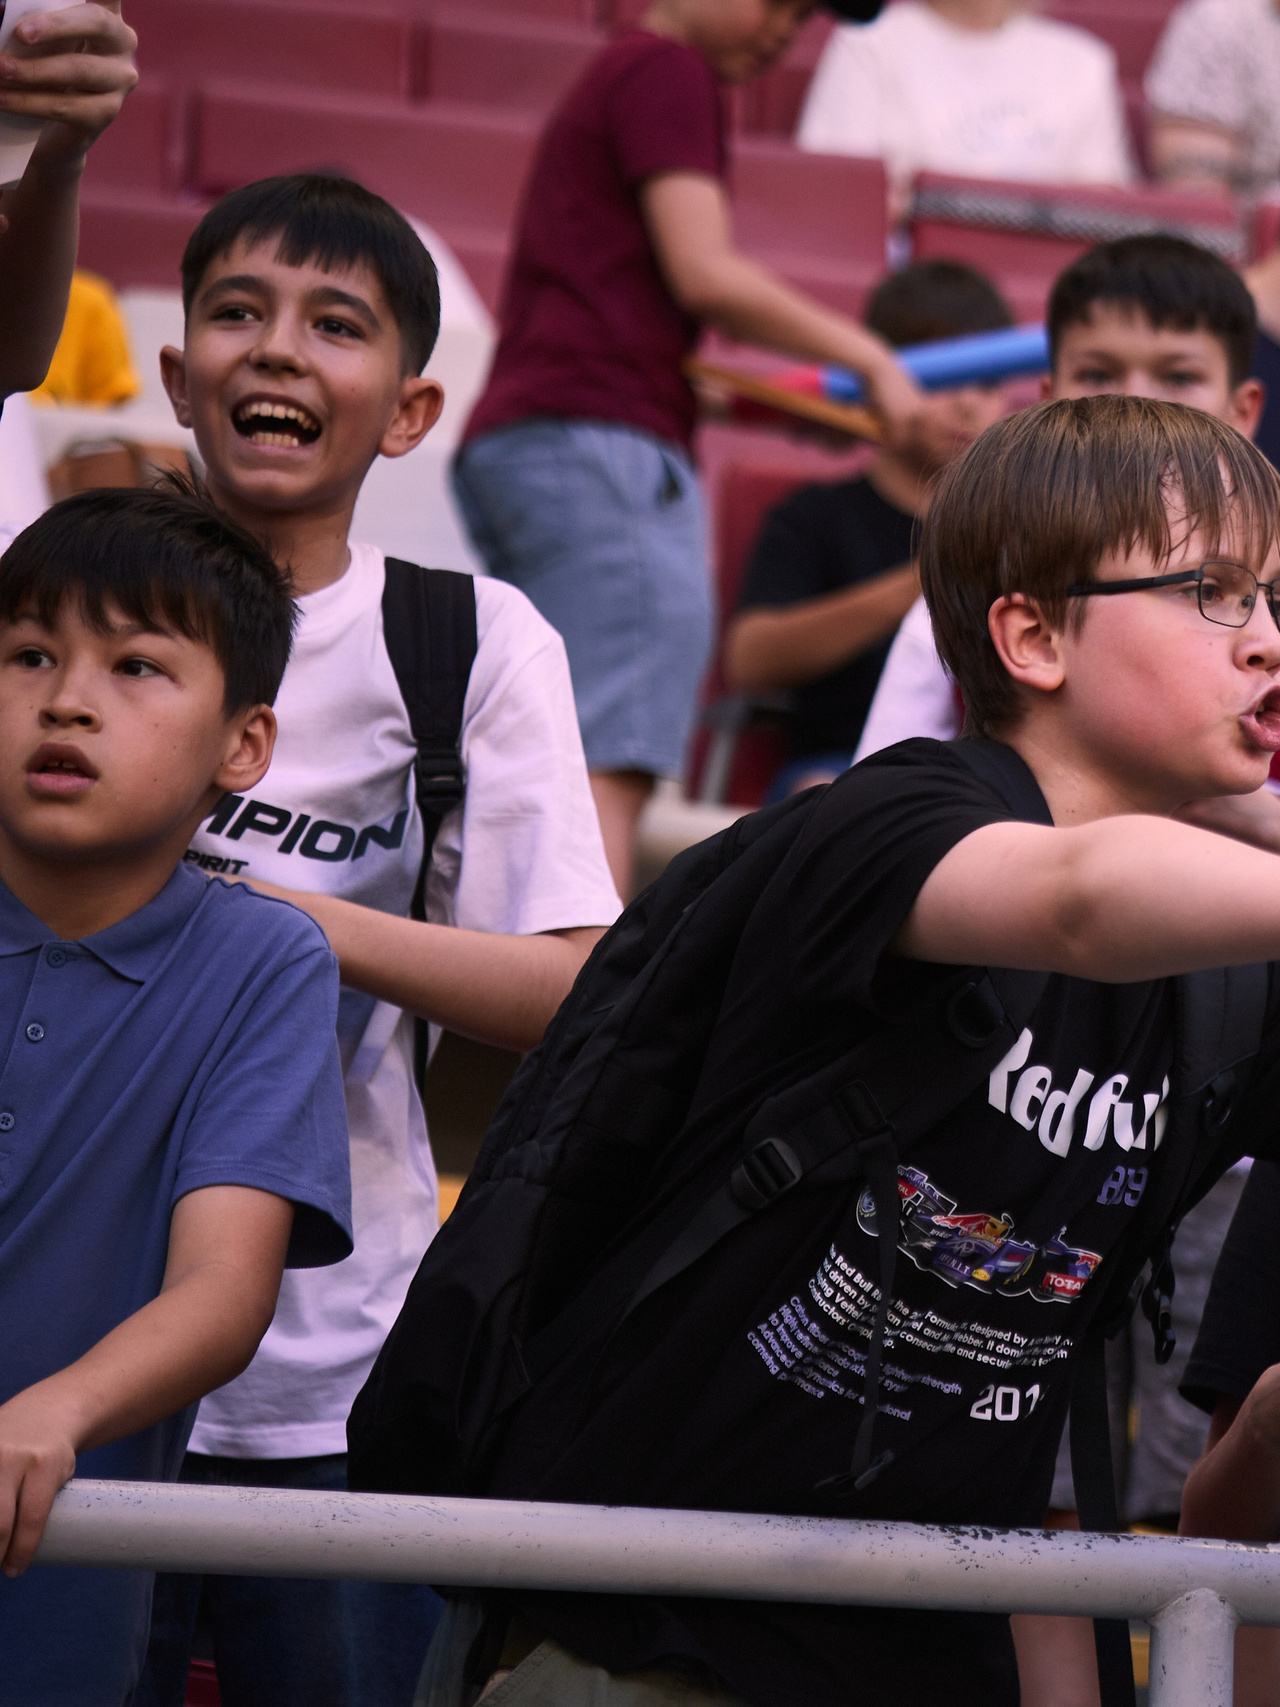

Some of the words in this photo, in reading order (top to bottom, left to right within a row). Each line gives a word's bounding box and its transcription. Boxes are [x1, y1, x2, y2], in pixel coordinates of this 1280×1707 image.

[834, 1254, 856, 1278] Red
[852, 1271, 874, 1294] Bull
[969, 1321, 1012, 1342] designed
[1012, 1333, 1028, 1348] by
[1049, 1274, 1085, 1291] TOTA
[828, 1270, 858, 1300] driven
[856, 1294, 871, 1310] by
[923, 1327, 943, 1341] and
[956, 1347, 976, 1361] and
[969, 1383, 1050, 1422] 201
